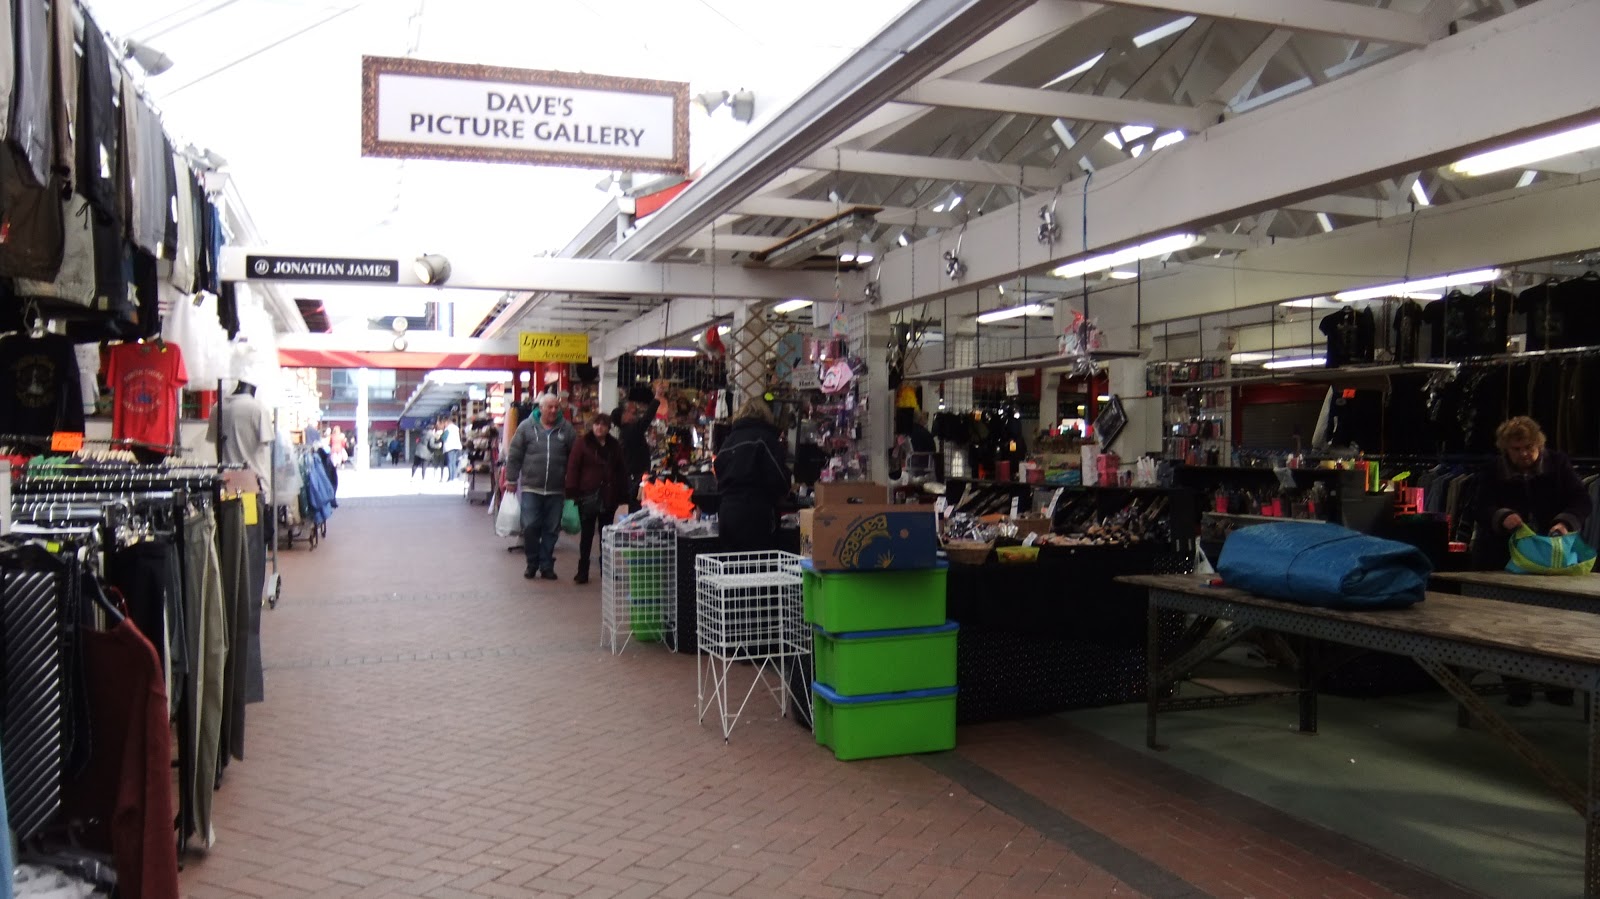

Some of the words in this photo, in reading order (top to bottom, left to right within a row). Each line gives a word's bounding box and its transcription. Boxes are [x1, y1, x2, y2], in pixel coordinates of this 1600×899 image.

[486, 91, 574, 117] DAVE'S
[409, 113, 525, 140] PICTURE
[533, 121, 646, 148] GALLERY
[273, 261, 345, 276] JONATHAN
[347, 263, 391, 277] JAMES
[523, 335, 561, 349] Lynn's
